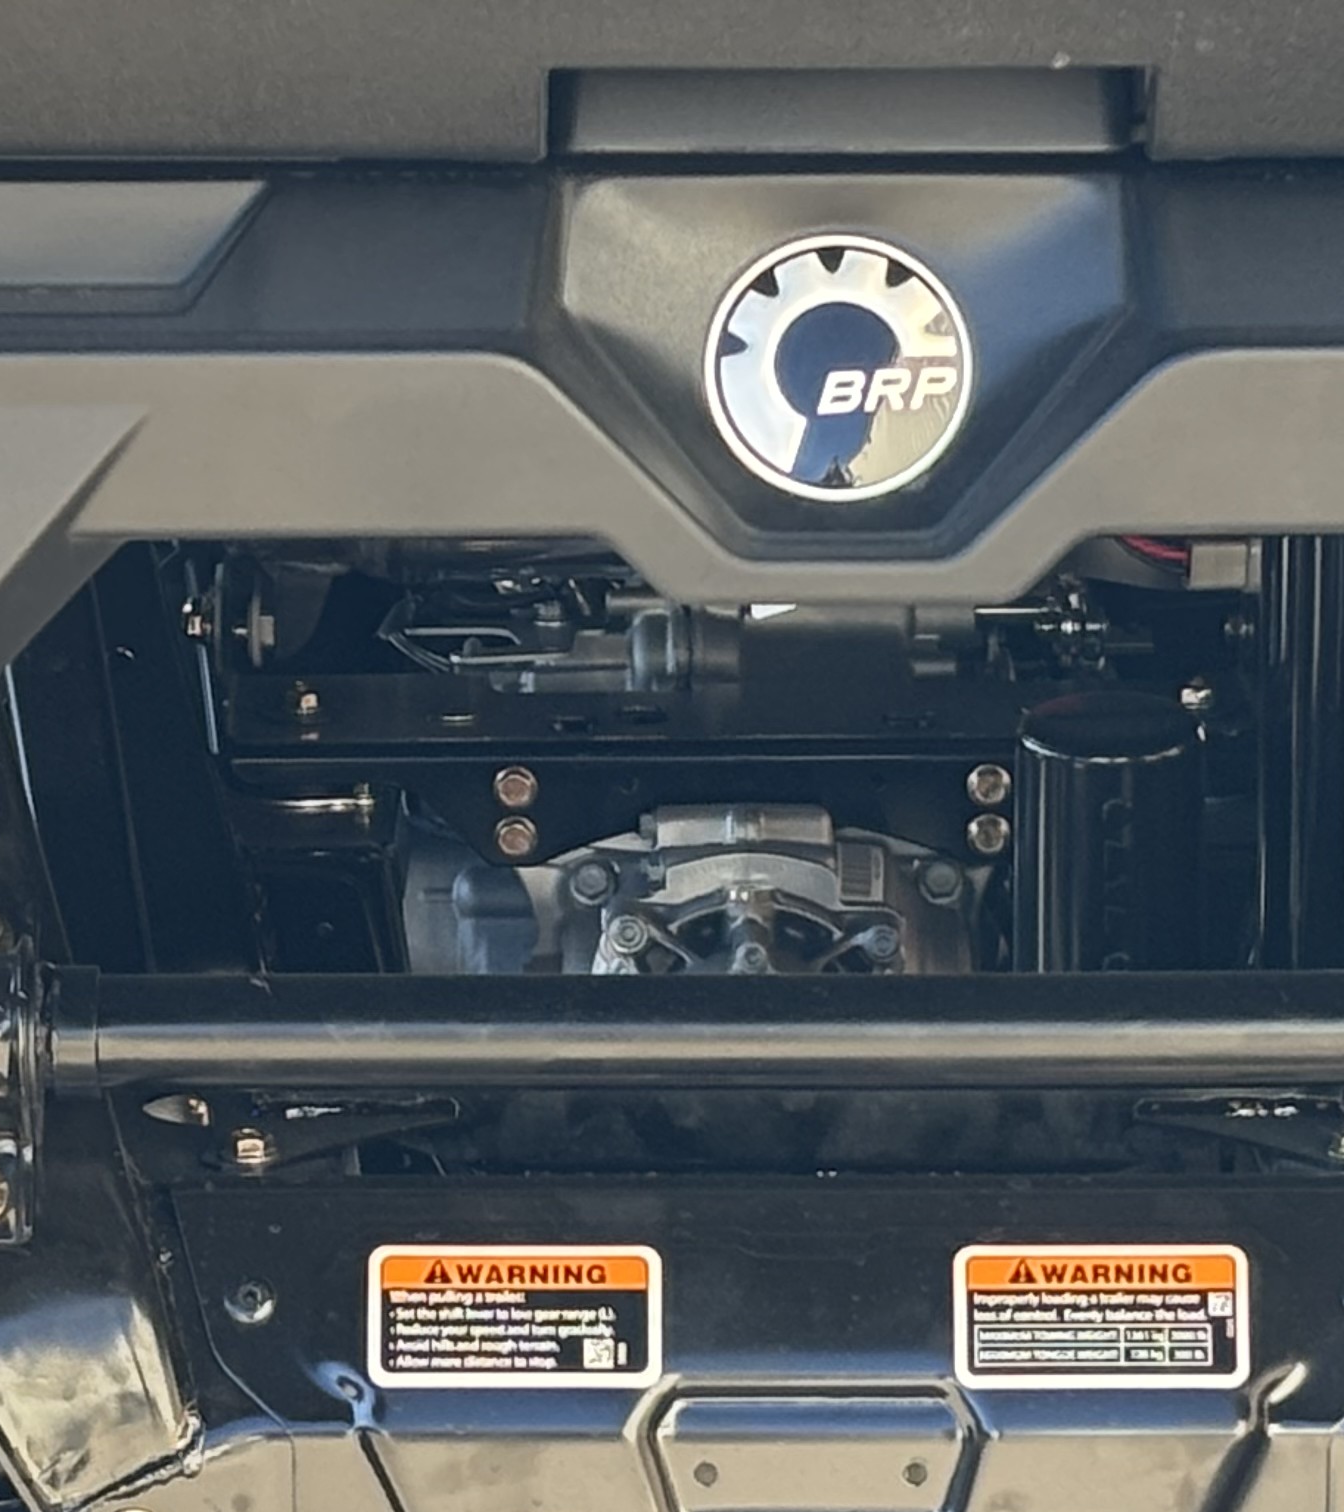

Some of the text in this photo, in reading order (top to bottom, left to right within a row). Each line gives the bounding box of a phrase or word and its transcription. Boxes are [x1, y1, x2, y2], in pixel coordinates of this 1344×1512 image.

[816, 366, 958, 416] BRP
[456, 1263, 607, 1285] WARNING
[1041, 1263, 1193, 1284] WARNING
